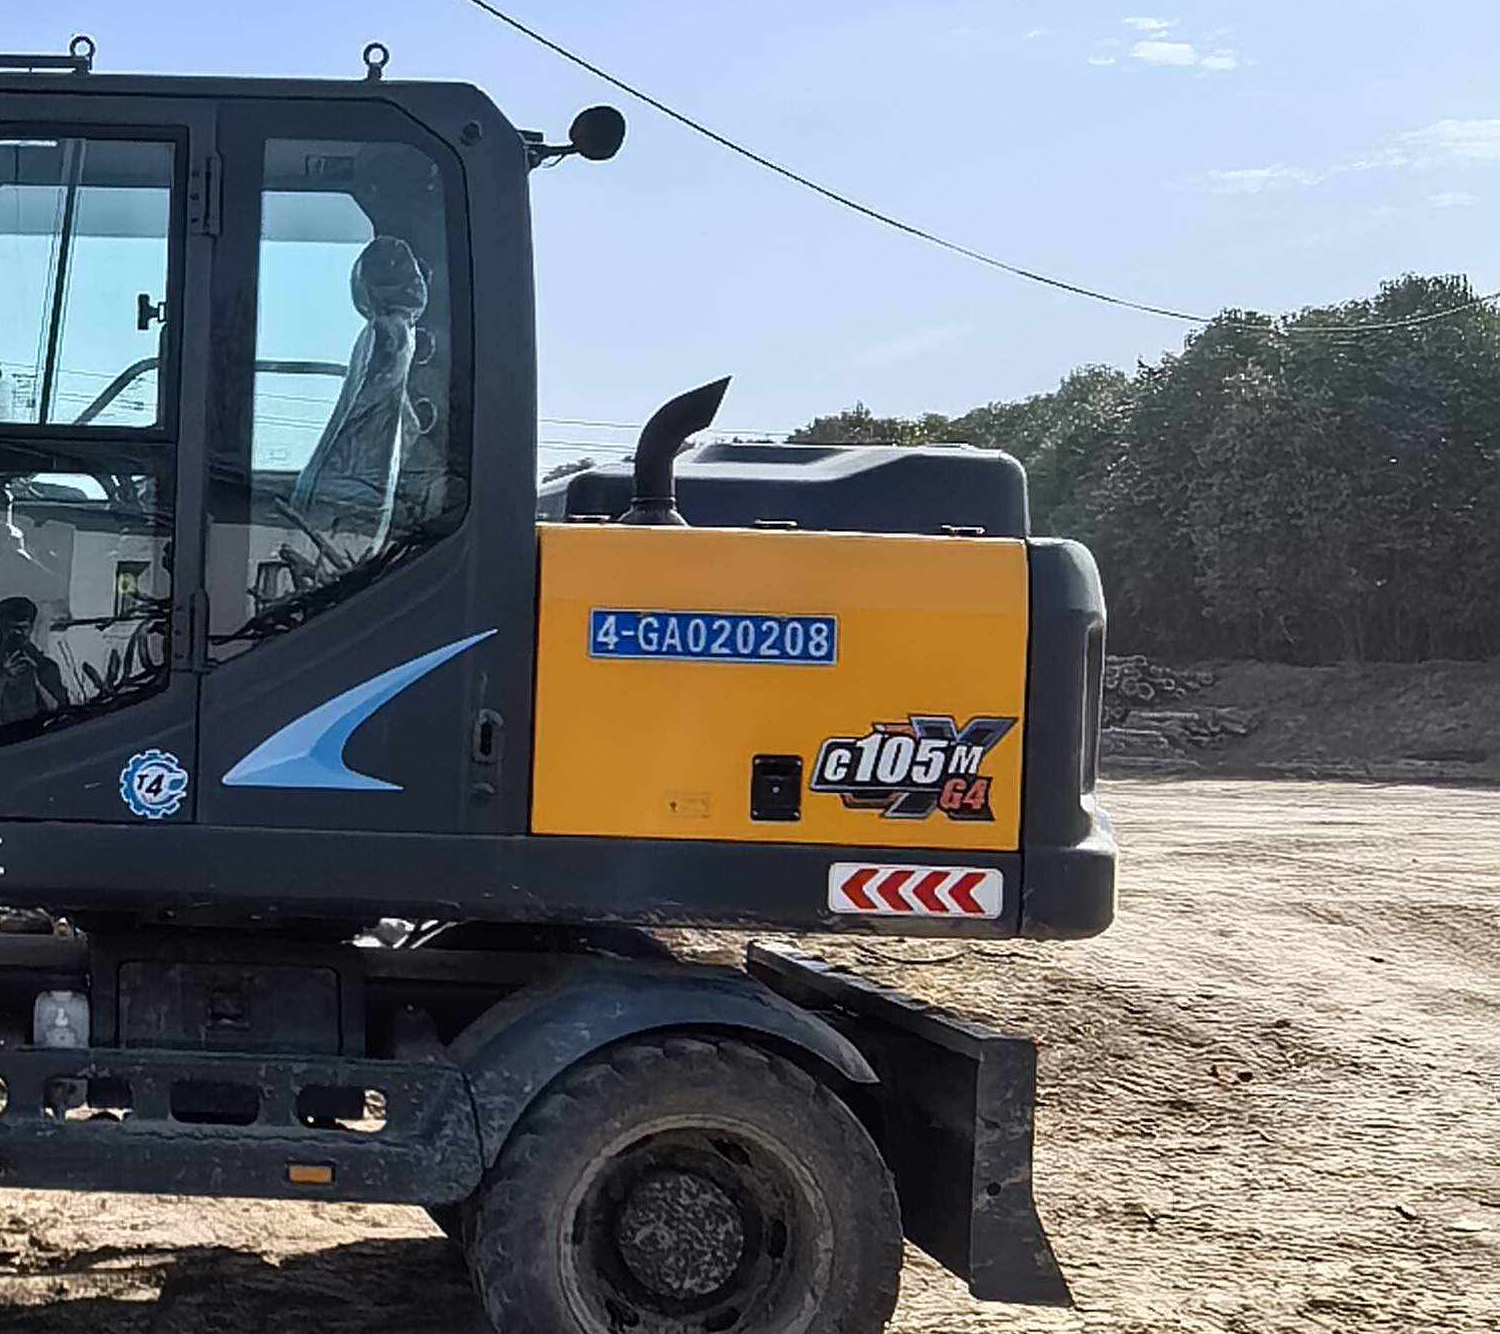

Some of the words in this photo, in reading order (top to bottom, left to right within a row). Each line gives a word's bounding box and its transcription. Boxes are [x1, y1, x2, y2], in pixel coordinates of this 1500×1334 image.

[596, 615, 830, 657] 4-GA020208
[137, 773, 165, 797] T4
[939, 777, 988, 811] G4
